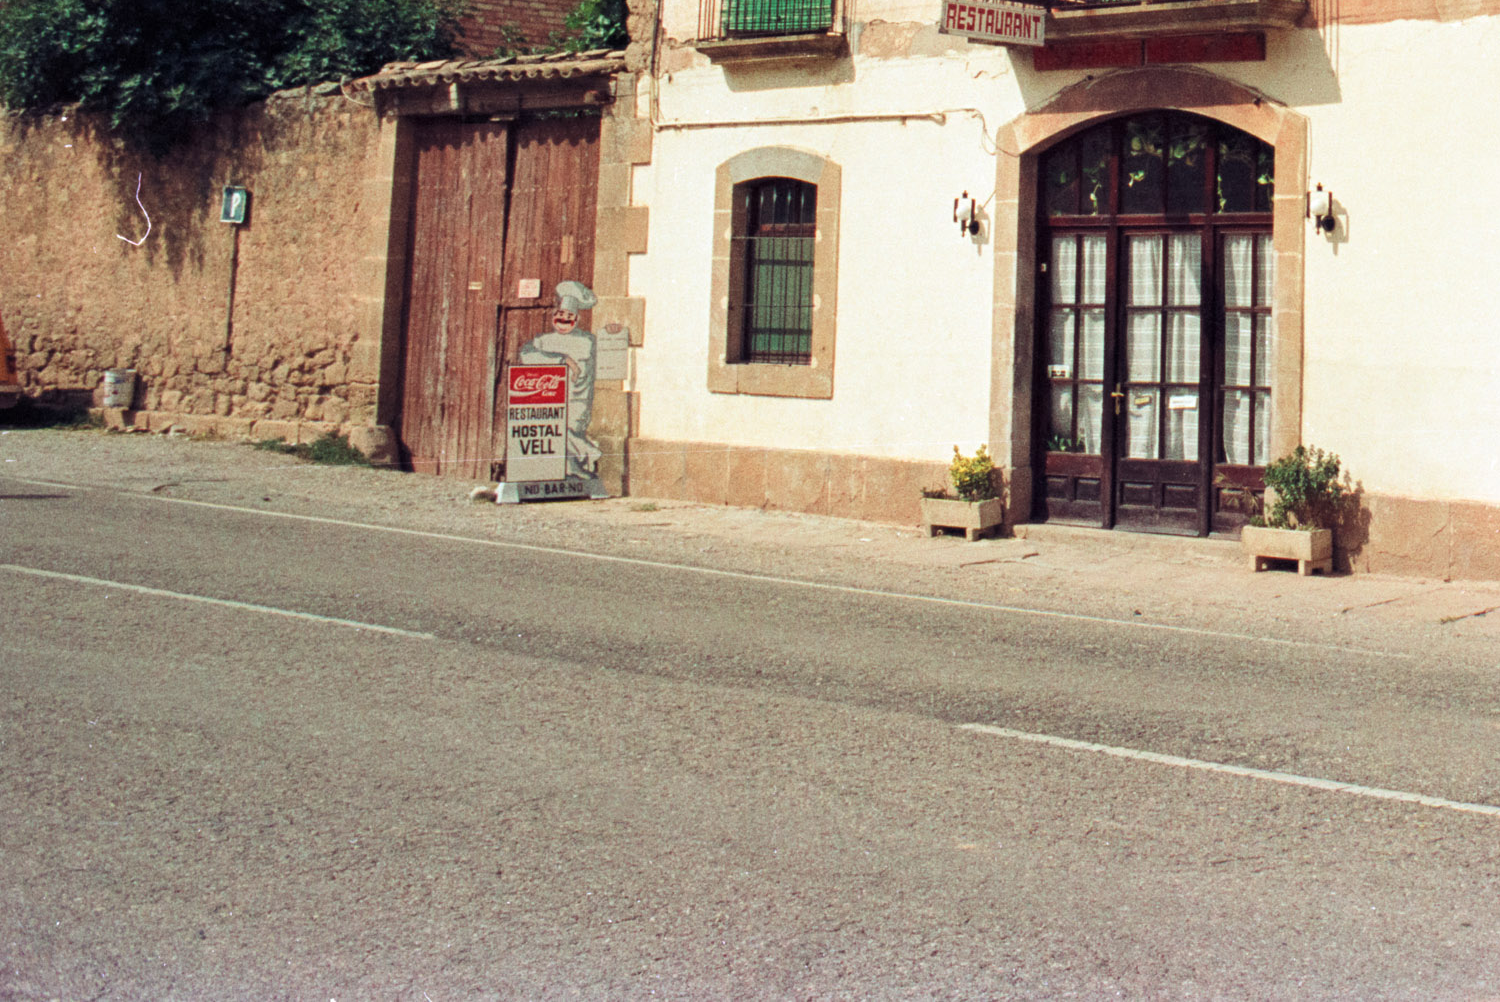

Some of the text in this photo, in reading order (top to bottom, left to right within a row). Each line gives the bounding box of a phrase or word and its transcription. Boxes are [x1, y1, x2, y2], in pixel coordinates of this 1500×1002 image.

[946, 2, 1041, 39] RESTAURANT
[230, 192, 242, 218] P
[509, 407, 565, 420] RESTAURANT
[512, 424, 562, 438] HOSTAL
[520, 439, 555, 455] VELL
